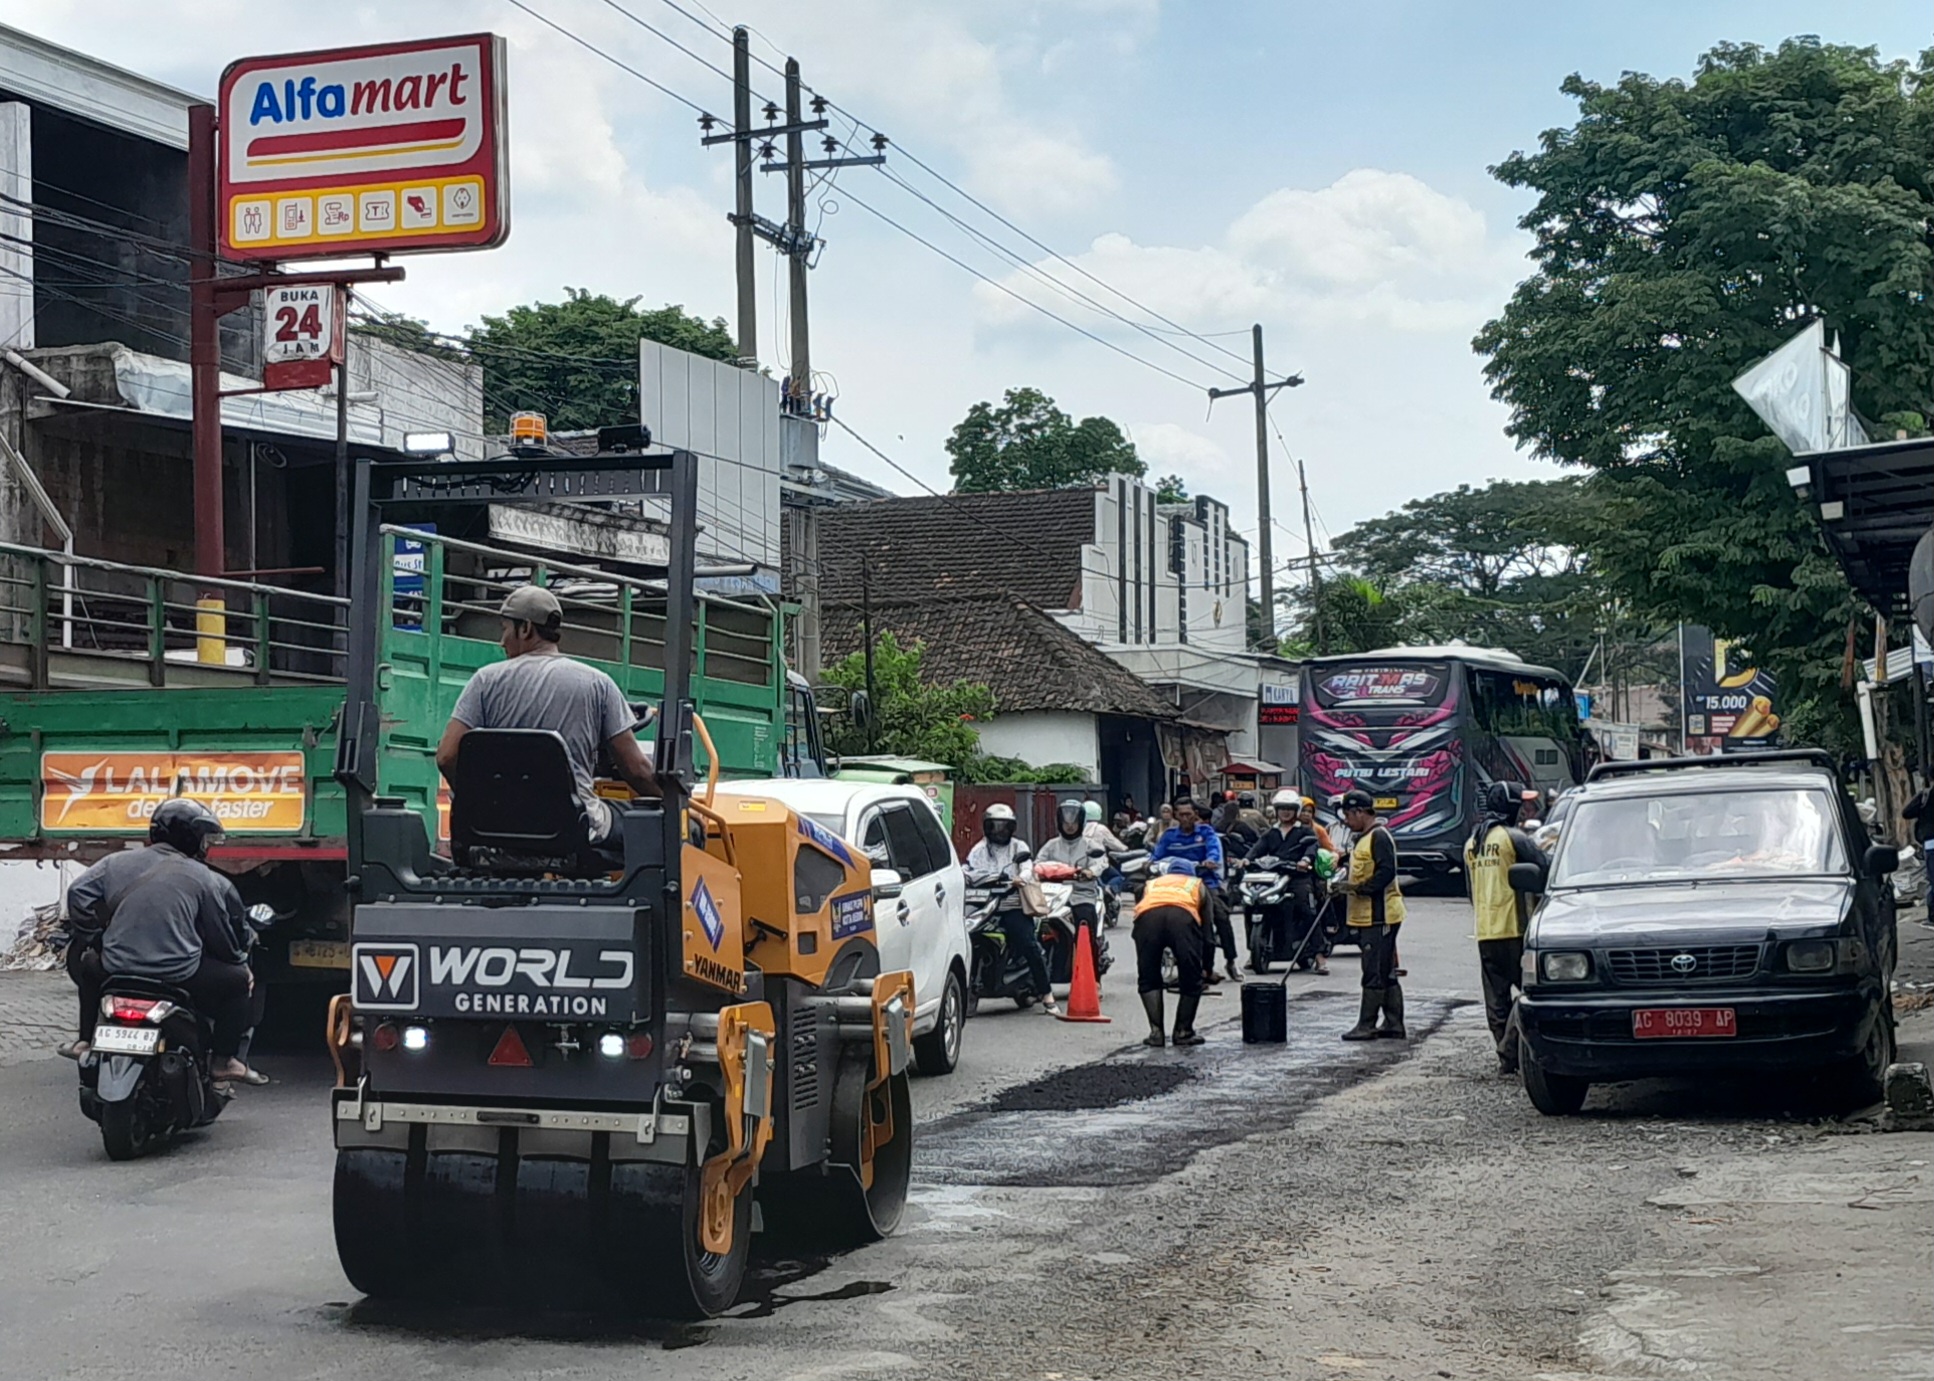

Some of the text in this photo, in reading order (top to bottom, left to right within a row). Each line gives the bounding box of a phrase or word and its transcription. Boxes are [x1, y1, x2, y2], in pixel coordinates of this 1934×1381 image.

[249, 63, 469, 126] Alfamart
[280, 290, 319, 302] BUKA
[275, 304, 323, 342] 24
[283, 343, 320, 354] JAM
[1368, 685, 1406, 694] TRANS
[1706, 695, 1747, 710] 15.000
[105, 766, 300, 795] LALAMOVE
[1378, 768, 1430, 777] LESTARI
[211, 798, 274, 818] faster
[430, 946, 634, 988] WORLD
[694, 953, 741, 990] YANMAR
[455, 993, 606, 1015] GENERATION
[1634, 1010, 1733, 1029] AG 8039 AP
[98, 1028, 111, 1038] AG
